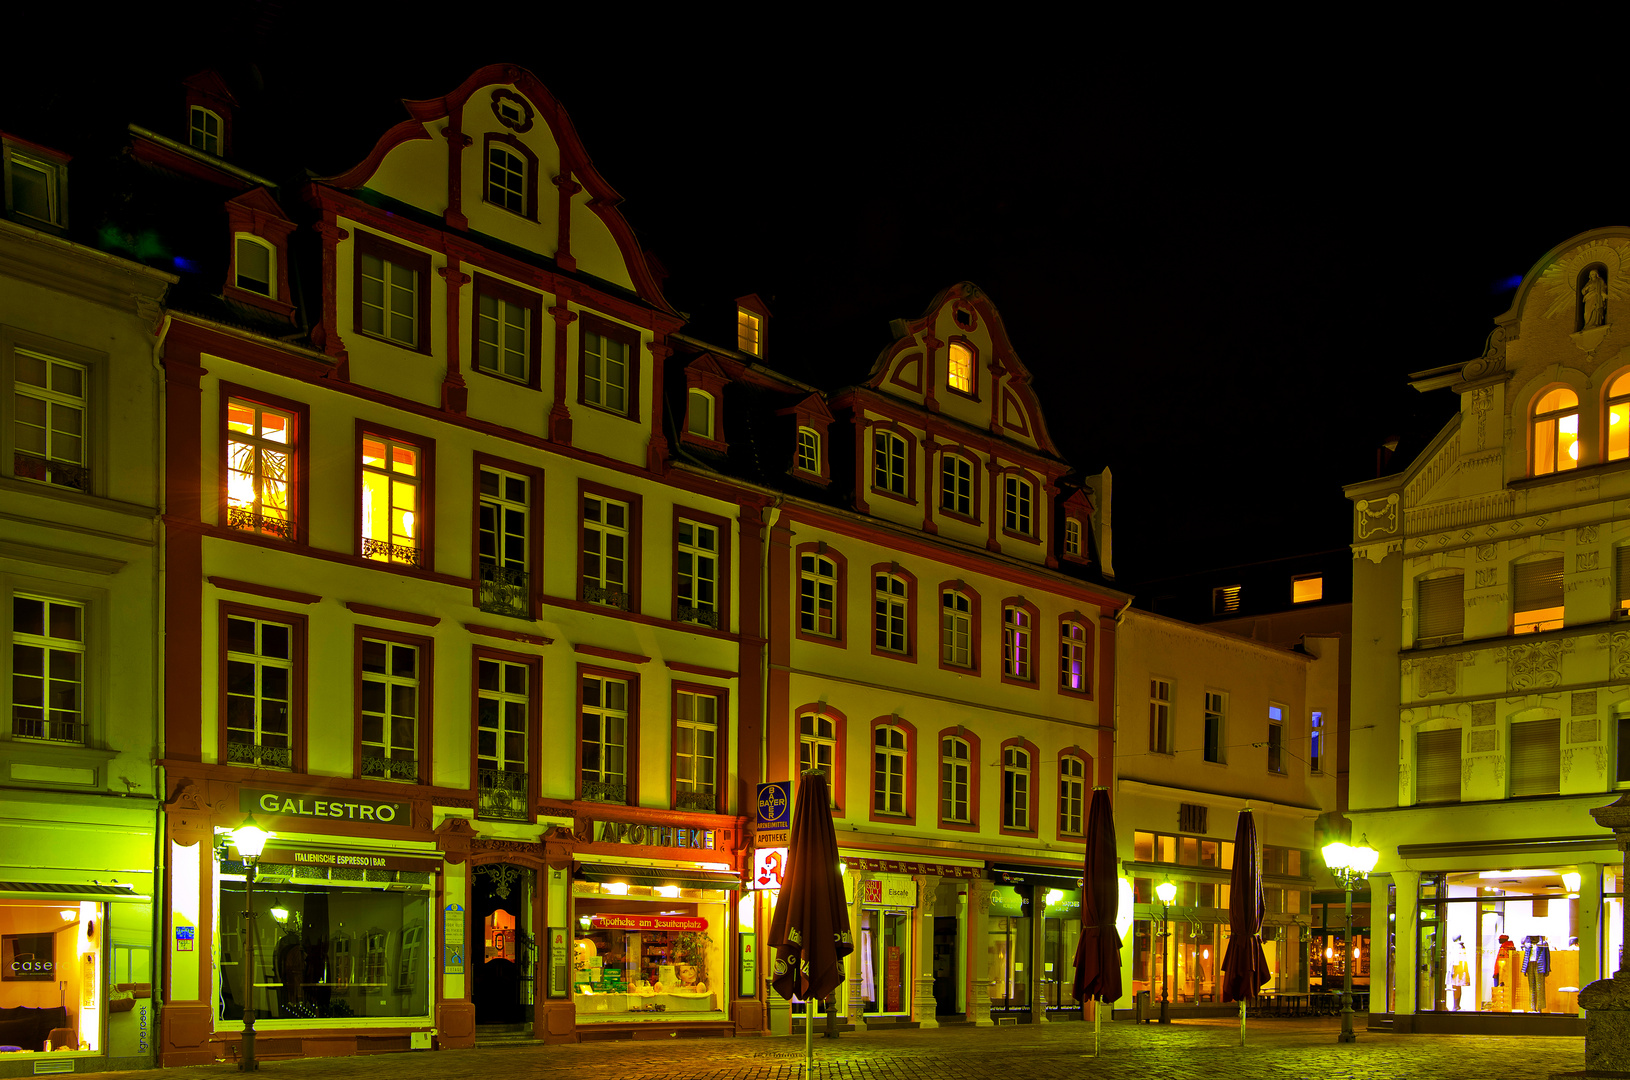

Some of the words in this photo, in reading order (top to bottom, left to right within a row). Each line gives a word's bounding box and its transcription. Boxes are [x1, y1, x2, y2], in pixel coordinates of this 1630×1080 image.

[759, 798, 785, 807] BAYER
[599, 821, 716, 850] APOTHEKE
[758, 833, 787, 843] APOTHEKE
[294, 852, 336, 864] ITALIENISCHE
[336, 855, 370, 866] ESPRESSO
[373, 857, 386, 867] BAR
[600, 917, 635, 926] Apotheke
[639, 919, 652, 927] am
[139, 1005, 147, 1030] roset
[138, 1031, 149, 1054] ligne
